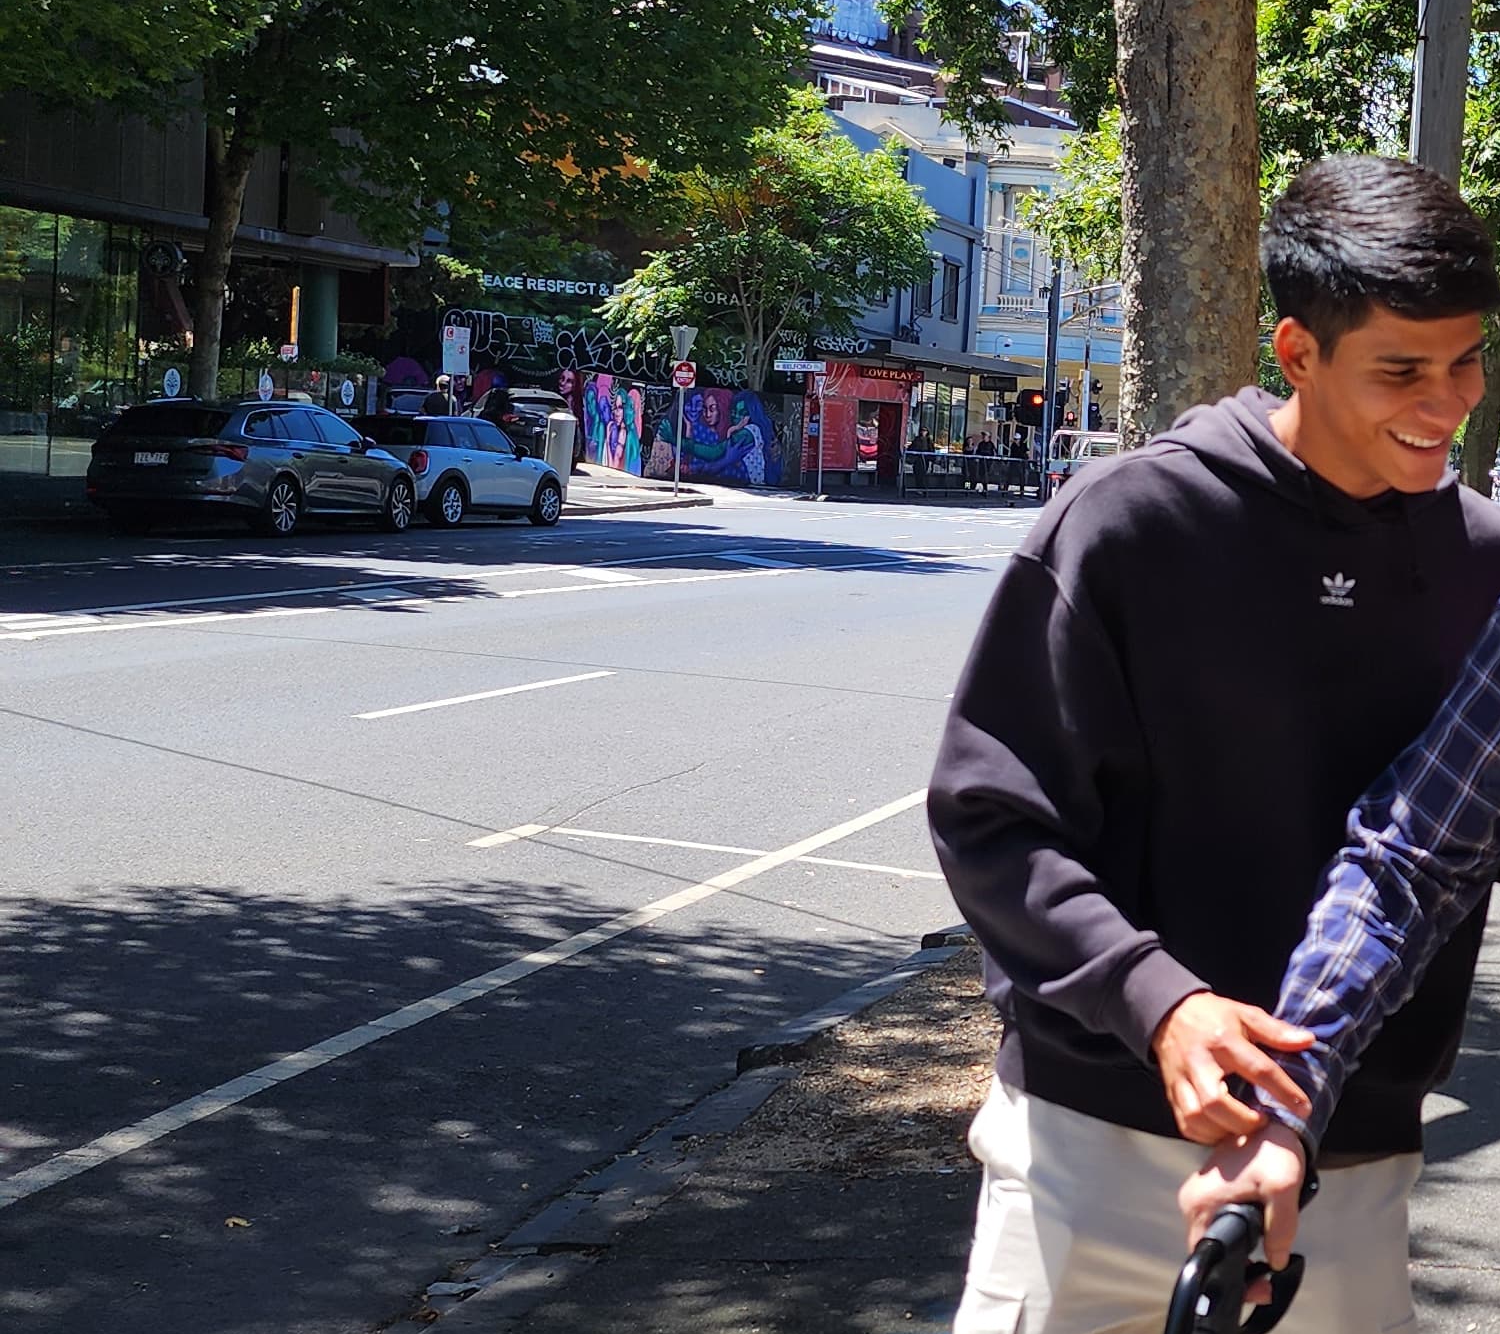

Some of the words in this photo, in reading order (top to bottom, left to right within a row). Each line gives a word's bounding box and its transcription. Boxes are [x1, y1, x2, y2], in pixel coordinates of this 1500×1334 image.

[483, 274, 524, 289] EACE
[526, 277, 597, 295] RESPECT
[598, 283, 609, 296] &
